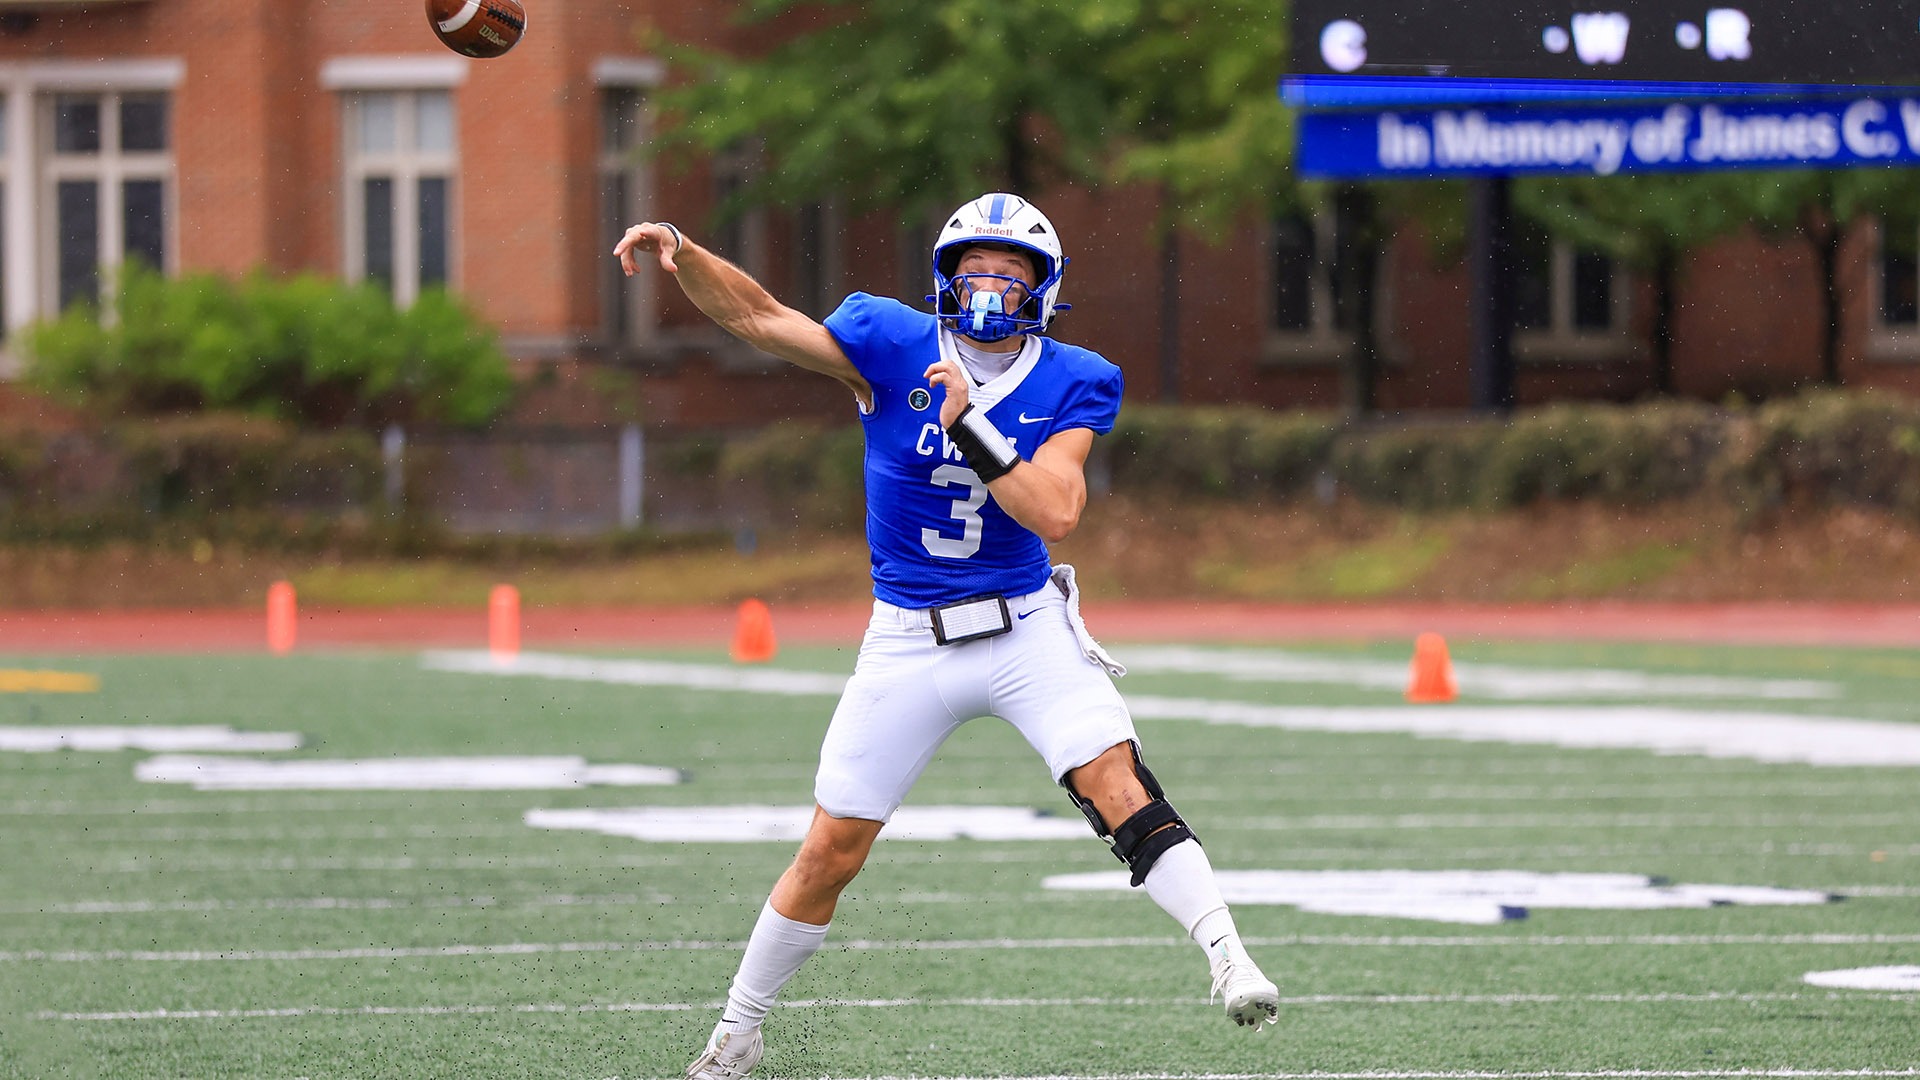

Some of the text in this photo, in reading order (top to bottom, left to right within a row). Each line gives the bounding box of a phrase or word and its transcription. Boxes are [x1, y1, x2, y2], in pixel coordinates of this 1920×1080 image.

[478, 23, 508, 47] Wilson
[1378, 113, 1431, 167] In
[1433, 111, 1628, 175] Memory
[1630, 103, 1692, 162] of
[1690, 104, 1840, 161] James
[1842, 99, 1900, 158] C.
[974, 226, 1013, 237] Riddell
[921, 463, 989, 559] 3
